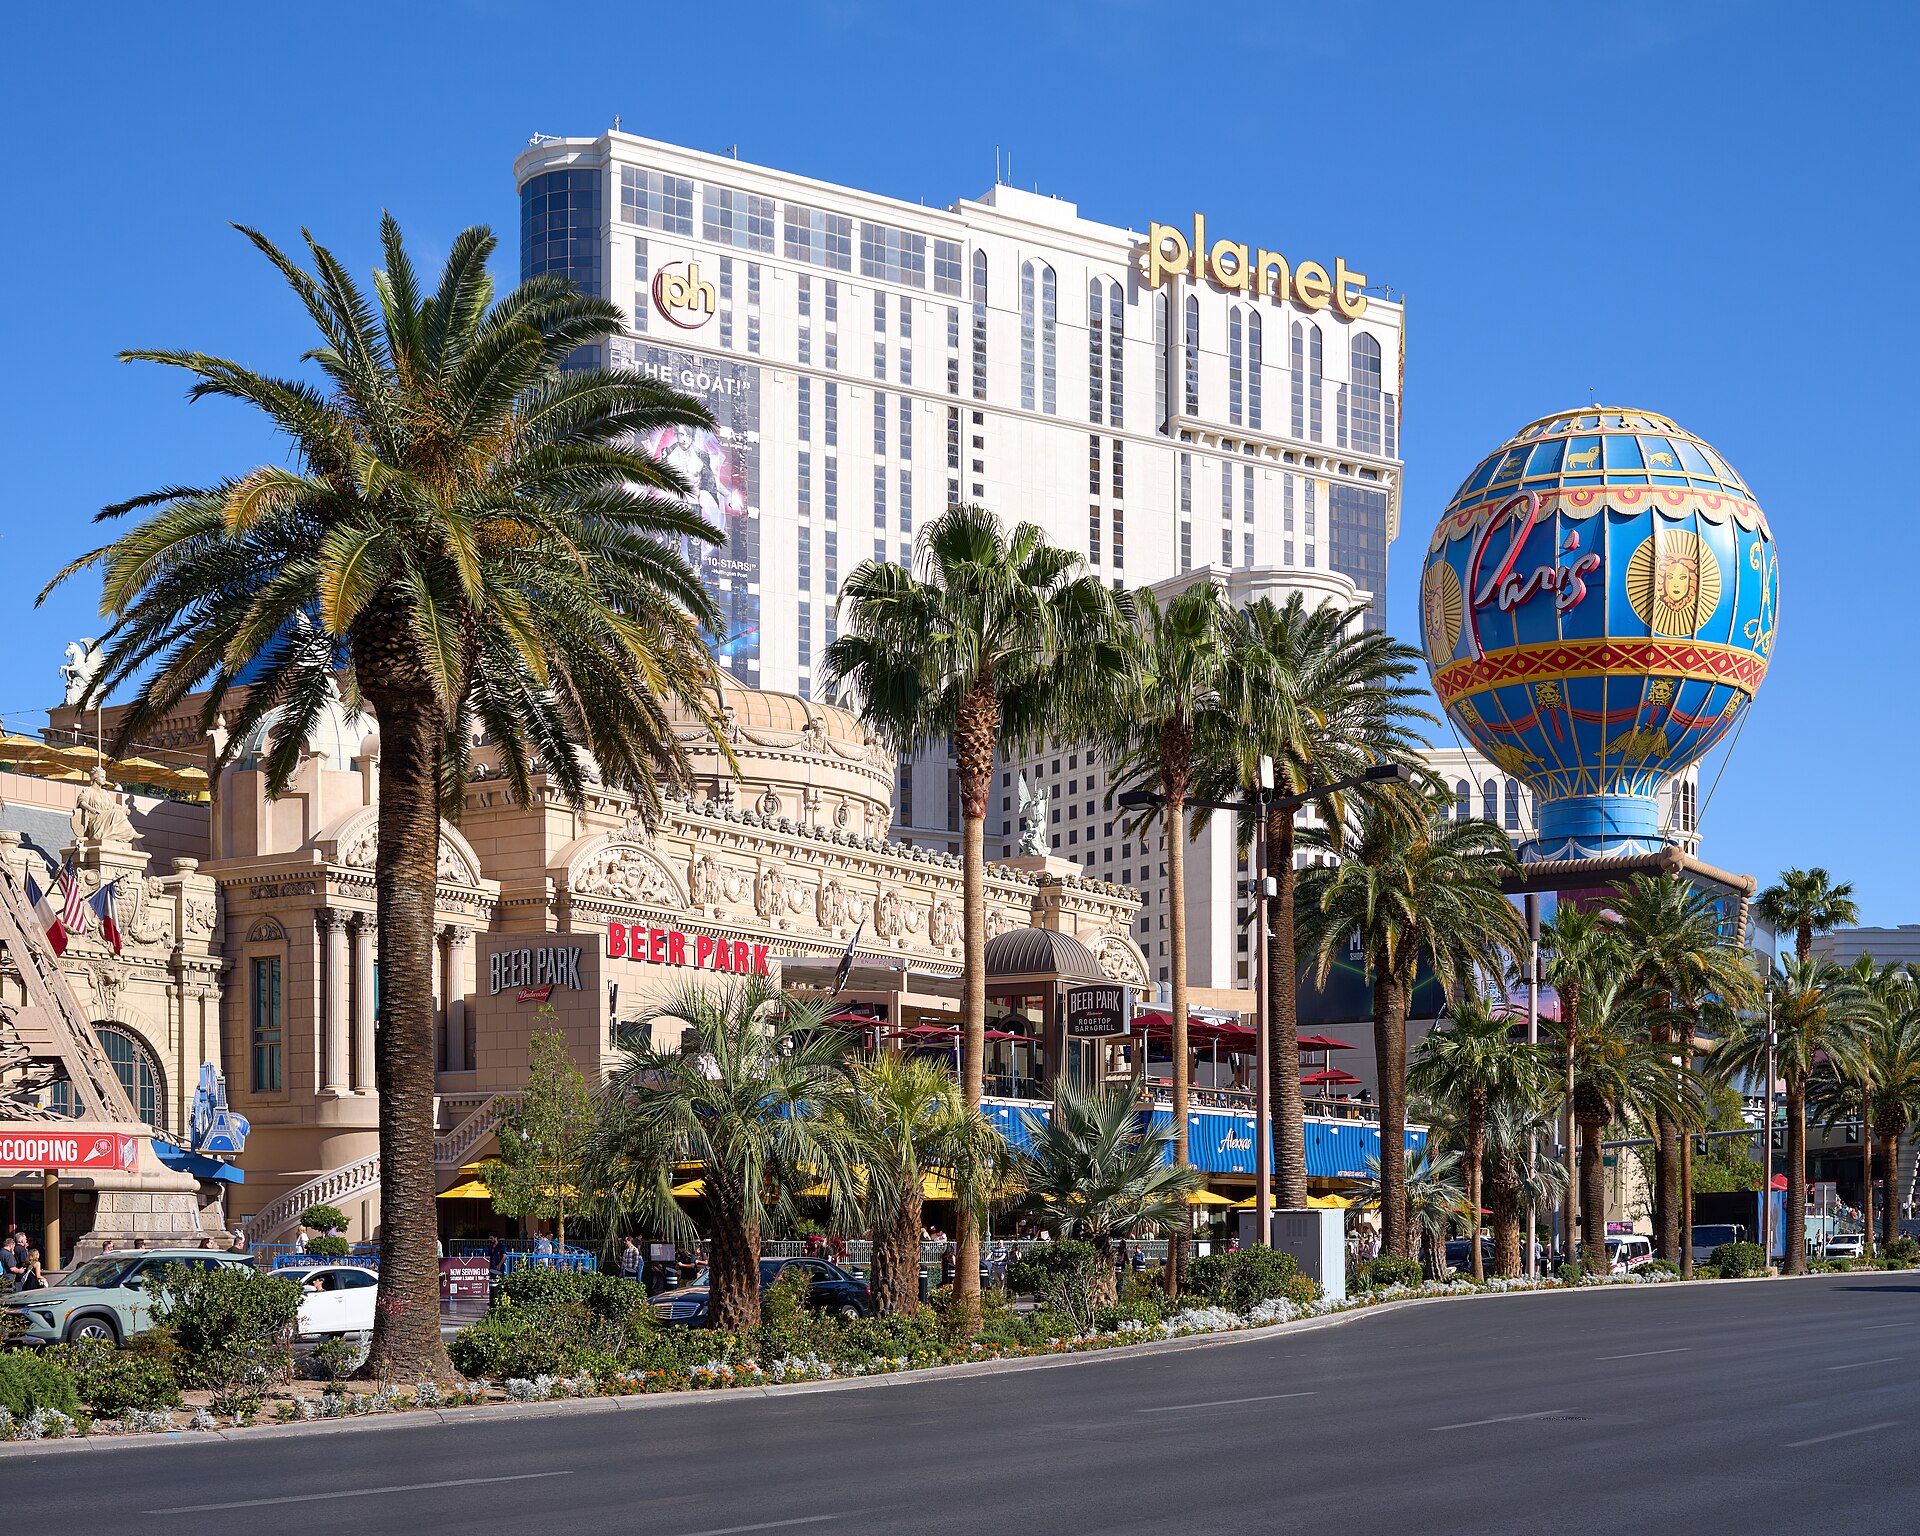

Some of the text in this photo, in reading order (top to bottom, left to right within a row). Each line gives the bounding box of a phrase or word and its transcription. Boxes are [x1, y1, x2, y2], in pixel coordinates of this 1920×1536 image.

[1148, 212, 1368, 319] planet
[659, 263, 716, 316] ph
[1465, 489, 1600, 663] Paris
[609, 922, 769, 976] BEER PARK
[490, 946, 583, 996] BEER PARK
[518, 990, 548, 999] Budweiser
[1070, 991, 1120, 1014] BEER PARK
[1078, 1017, 1111, 1026] ROOFTOP
[0, 1139, 78, 1162] COOPING
[450, 1268, 461, 1276] NOW
[462, 1268, 480, 1276] SERVING
